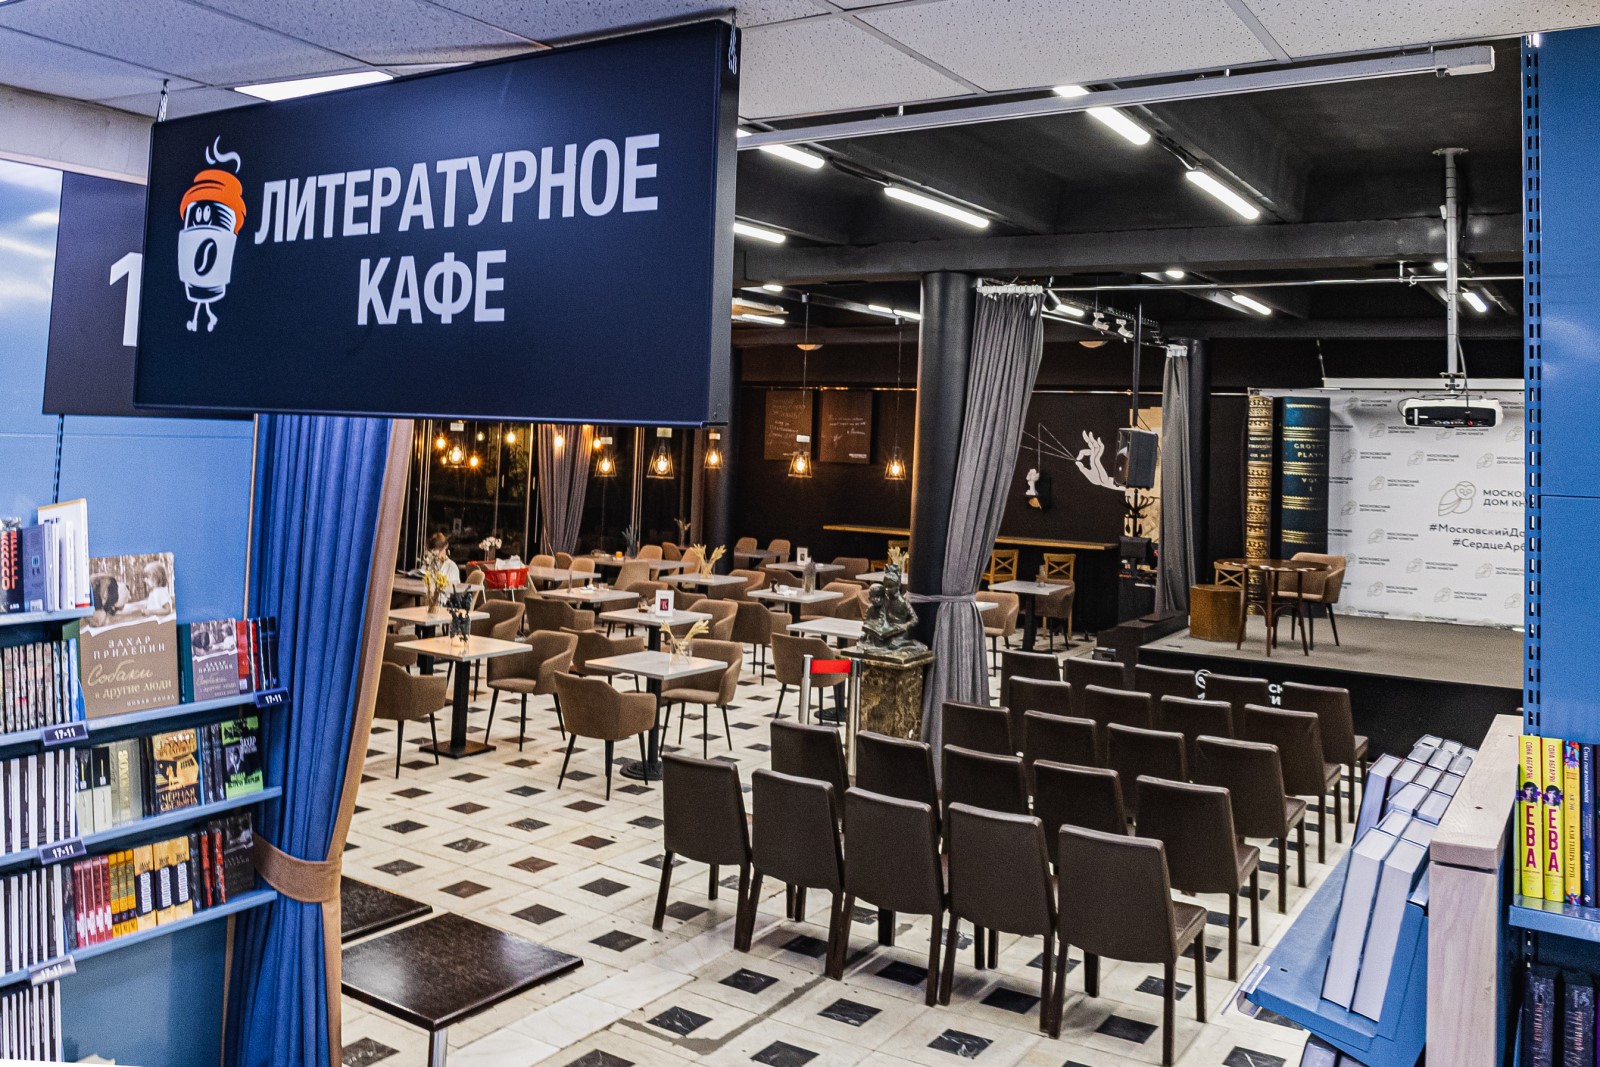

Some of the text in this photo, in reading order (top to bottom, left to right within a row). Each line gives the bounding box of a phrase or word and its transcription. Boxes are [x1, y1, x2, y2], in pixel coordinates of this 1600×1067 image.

[254, 133, 660, 245] ЛИТЕРАТУРНОЕ
[357, 249, 507, 326] КАФЕ
[1483, 489, 1525, 498] МОСКО
[1483, 498, 1508, 507] ДОМ
[1429, 523, 1525, 538] #МосковскийДо
[1452, 538, 1525, 552] #СердцеАрб
[108, 635, 151, 649] ЗАХАР
[93, 643, 165, 660] ПРИЛЕПИН
[87, 659, 153, 686] Собаки
[1525, 805, 1536, 868] ЕВА
[1548, 808, 1559, 872] ЕВА
